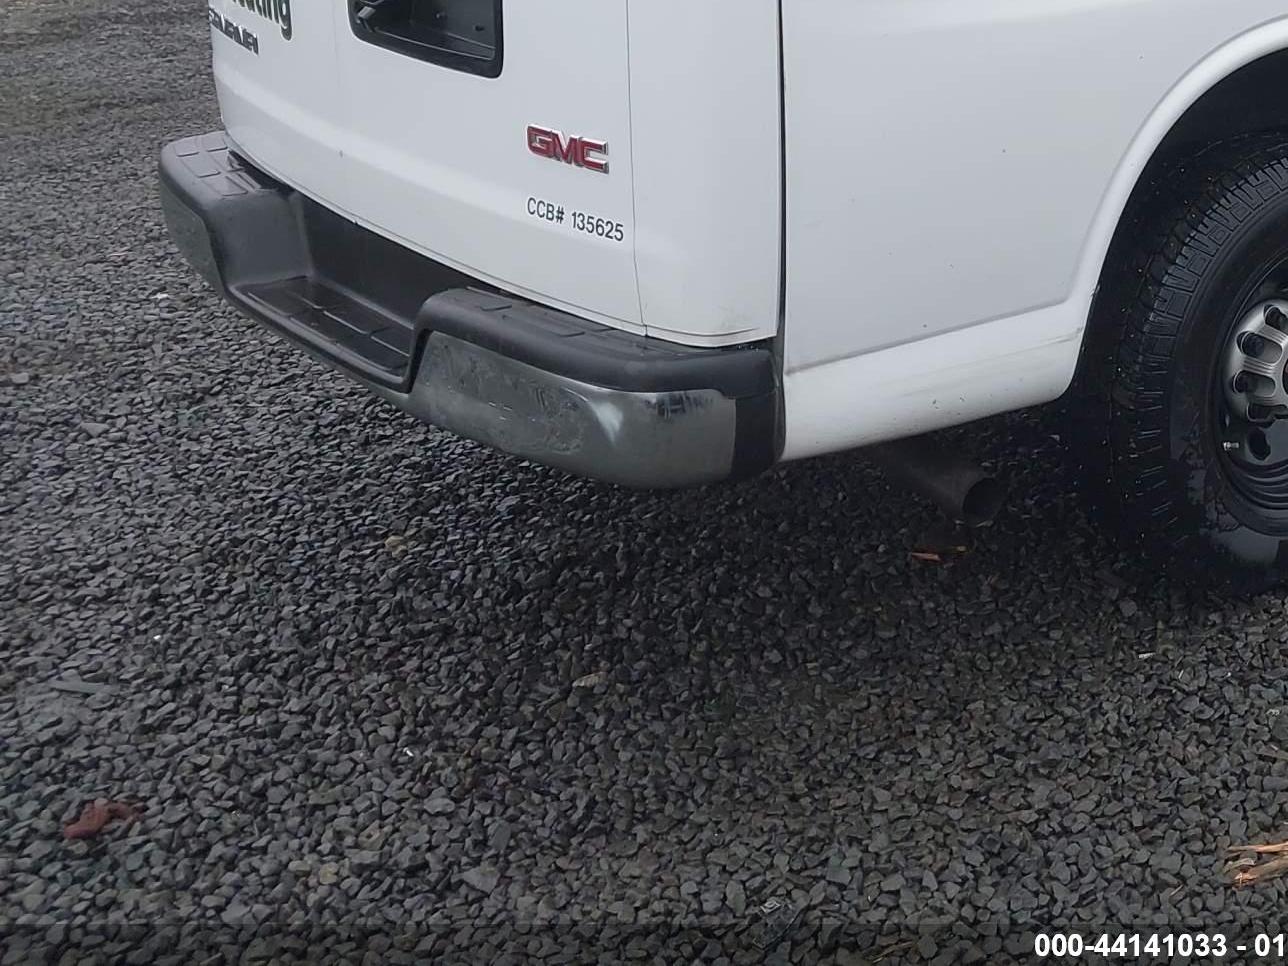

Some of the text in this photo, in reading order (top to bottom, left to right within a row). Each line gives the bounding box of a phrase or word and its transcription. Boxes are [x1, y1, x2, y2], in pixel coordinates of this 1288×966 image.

[526, 123, 609, 175] GMC
[527, 197, 624, 242] CCB# 135625
